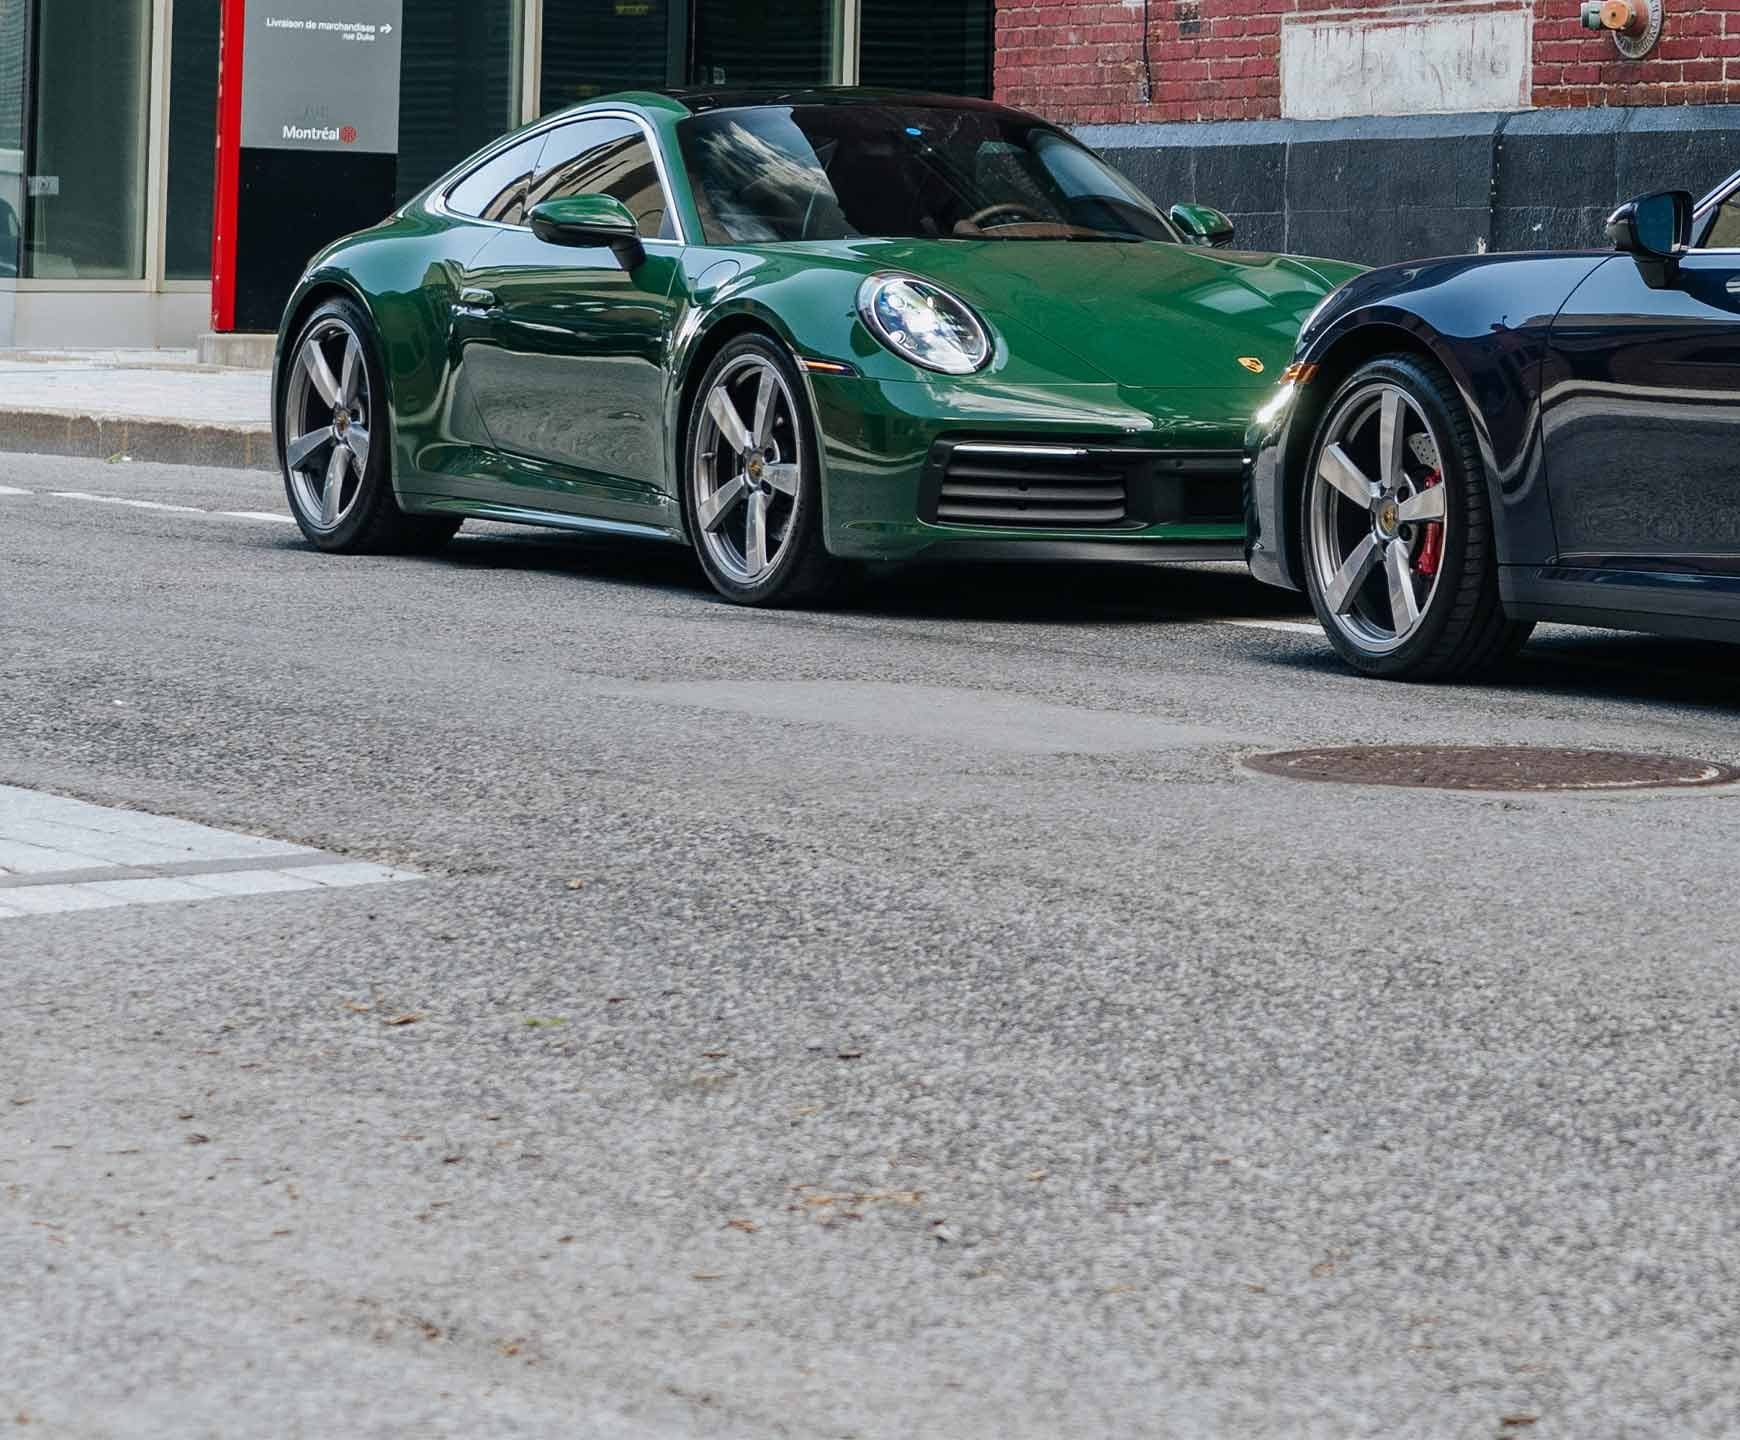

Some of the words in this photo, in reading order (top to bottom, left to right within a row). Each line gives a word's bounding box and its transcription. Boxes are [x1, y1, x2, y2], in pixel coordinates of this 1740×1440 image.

[266, 17, 304, 29] Livraison
[305, 20, 317, 30] de
[318, 21, 375, 33] marchandises
[282, 125, 340, 141] Montréal
